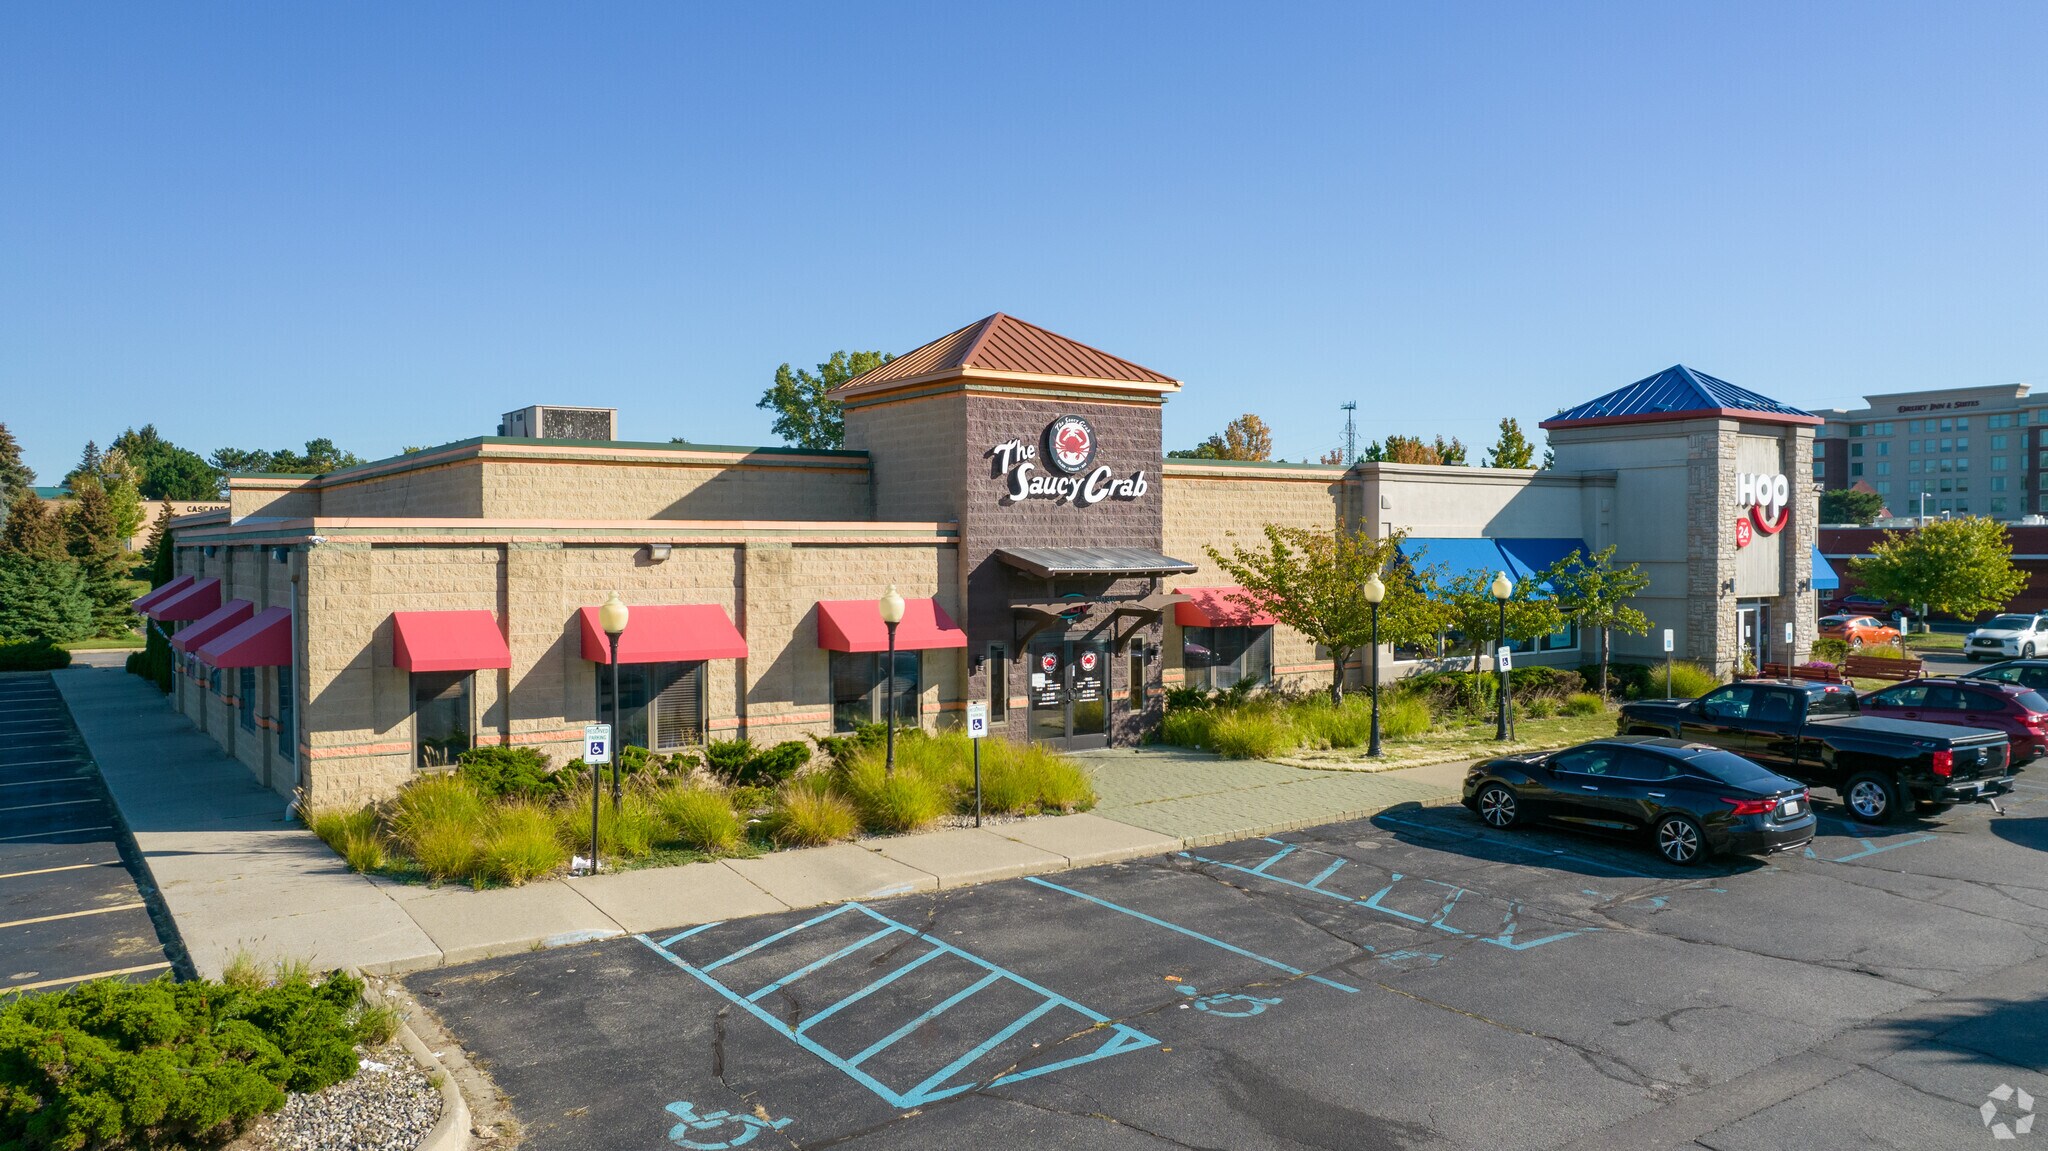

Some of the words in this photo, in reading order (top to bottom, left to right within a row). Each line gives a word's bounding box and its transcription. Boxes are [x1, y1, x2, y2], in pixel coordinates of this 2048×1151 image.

[1897, 404, 1928, 413] DRURY
[1929, 402, 1945, 411] INN
[1953, 400, 1980, 409] SUITES
[1054, 421, 1064, 431] The
[994, 439, 1036, 474] The
[1010, 462, 1086, 502] Saucy
[1084, 465, 1148, 503] Crab
[1738, 526, 1750, 539] 24
